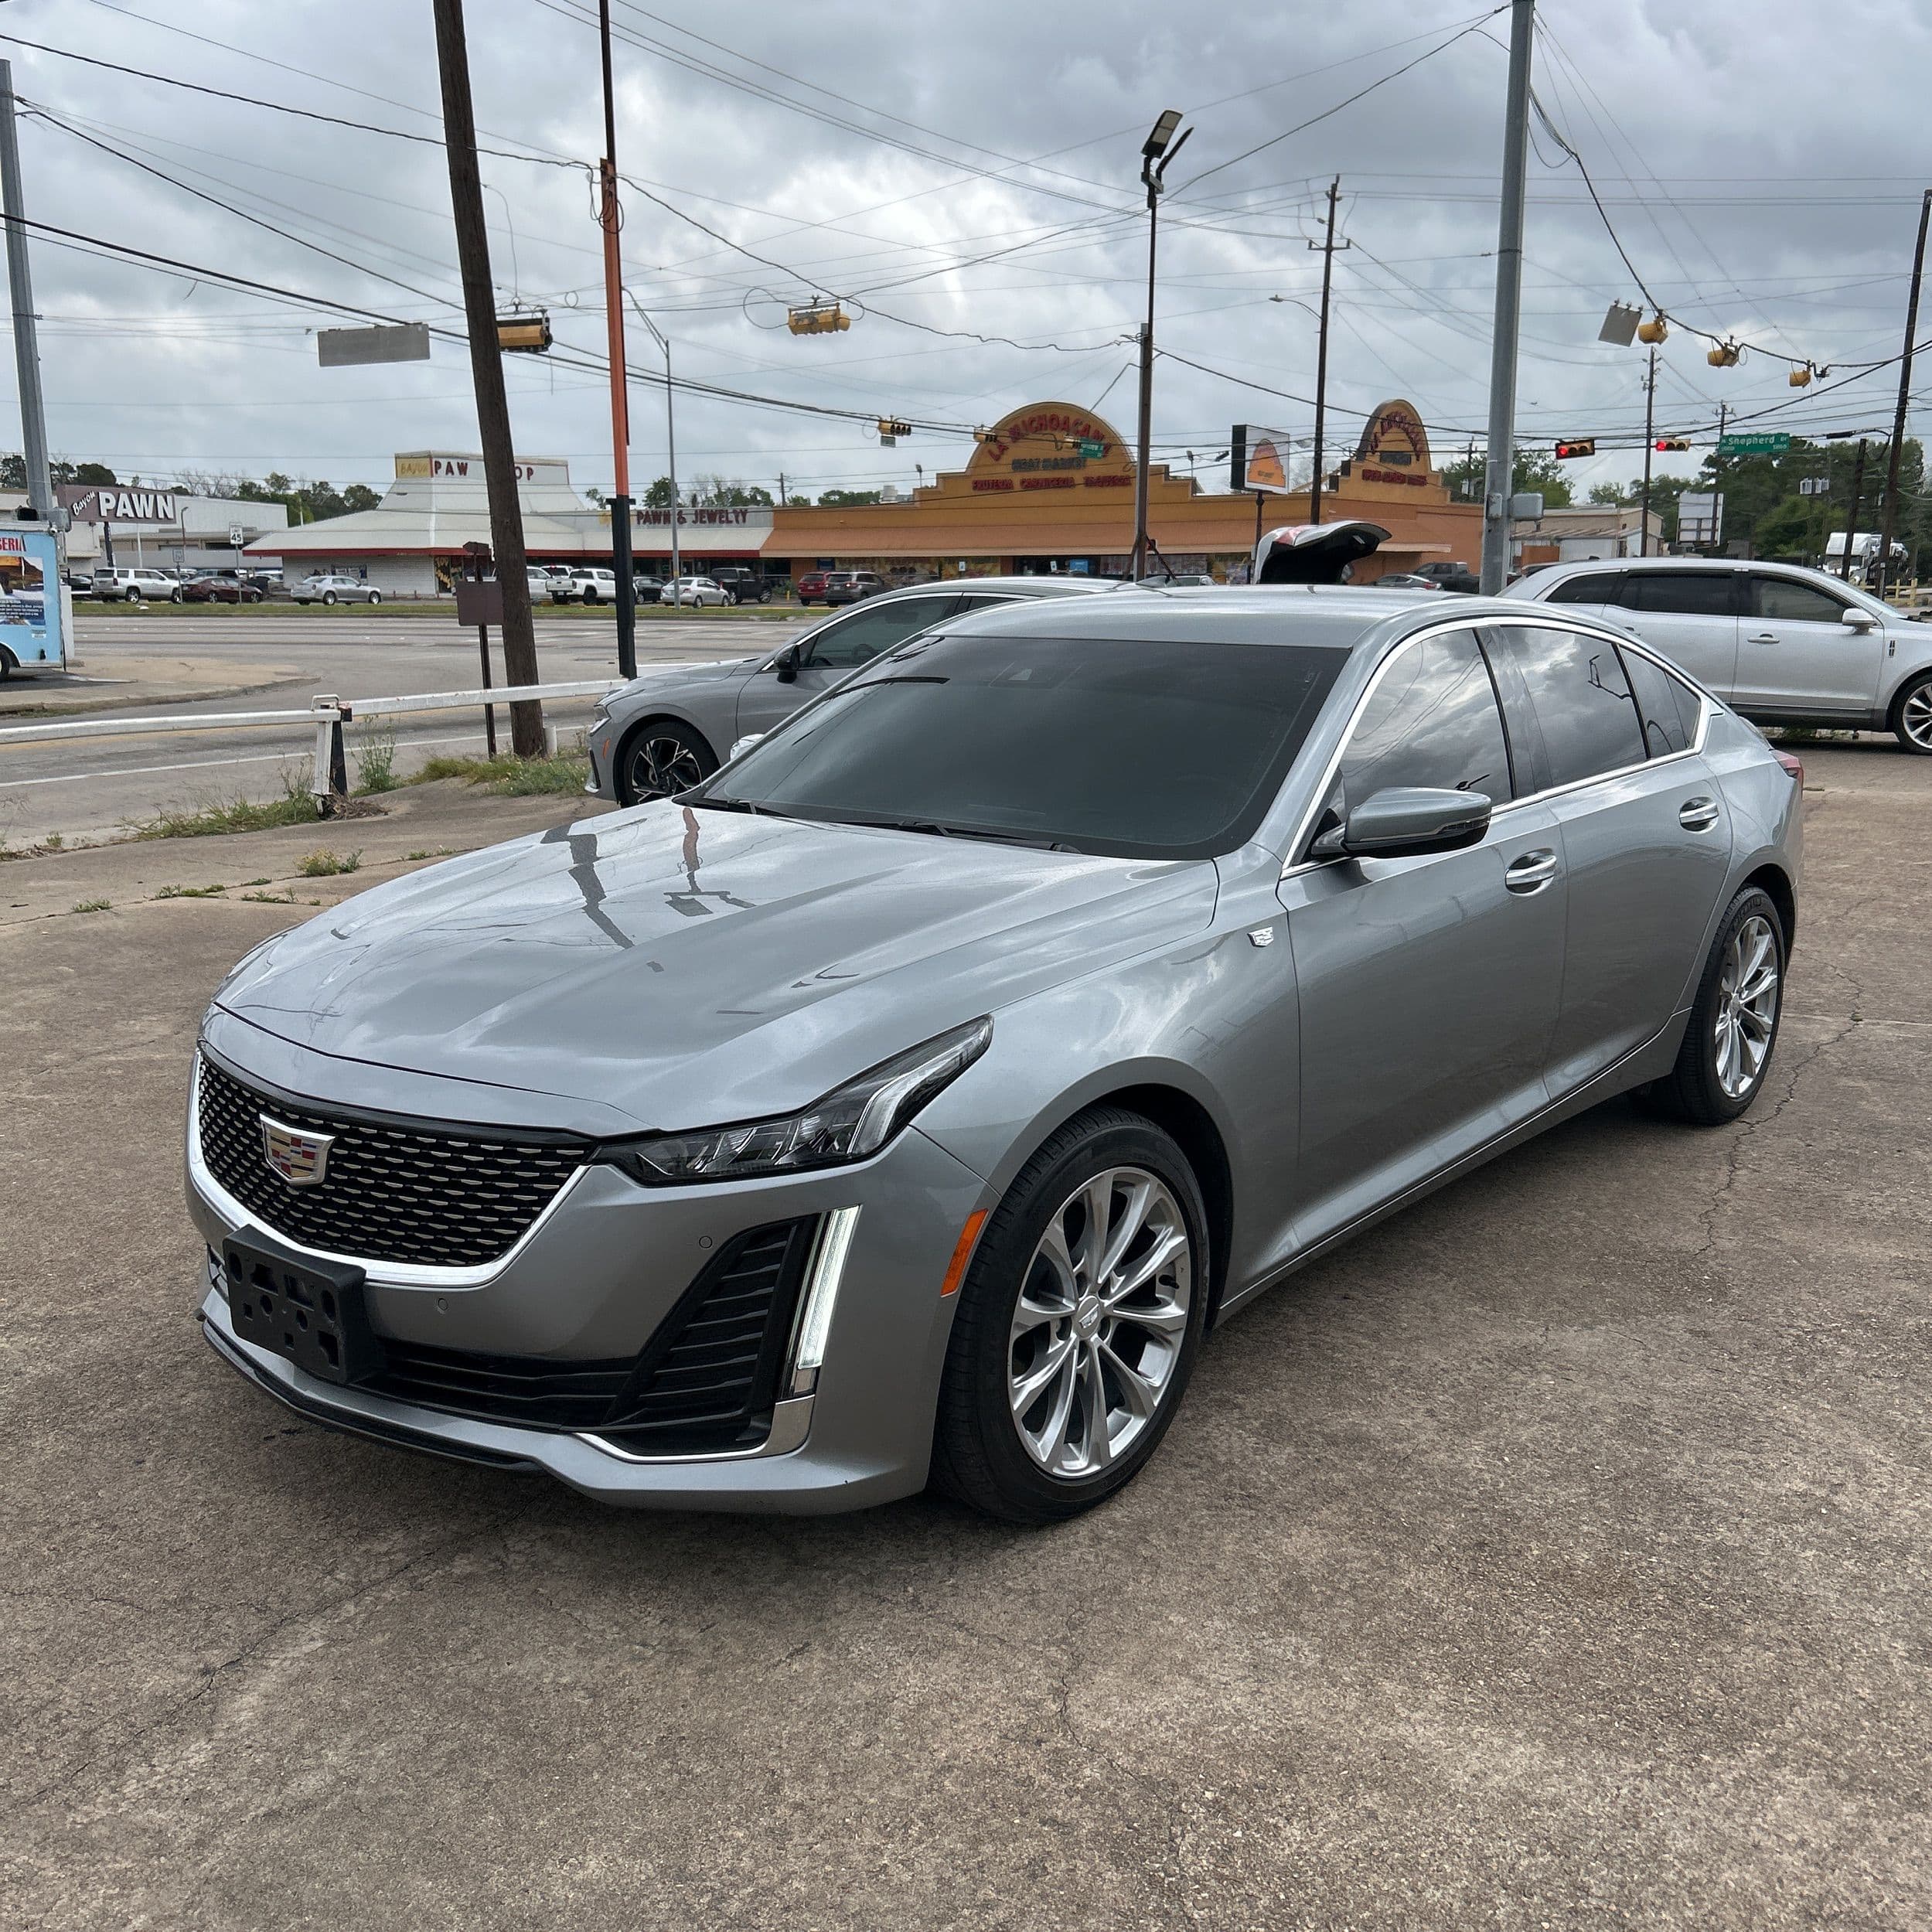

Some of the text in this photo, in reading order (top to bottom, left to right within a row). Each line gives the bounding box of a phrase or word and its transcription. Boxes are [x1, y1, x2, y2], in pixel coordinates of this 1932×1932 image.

[1728, 436, 1775, 447] Shepherd
[513, 466, 534, 481] OP
[73, 490, 174, 520] Bayou PAWN
[636, 509, 671, 525] PAWN
[676, 510, 687, 525] &
[231, 533, 242, 542] 45
